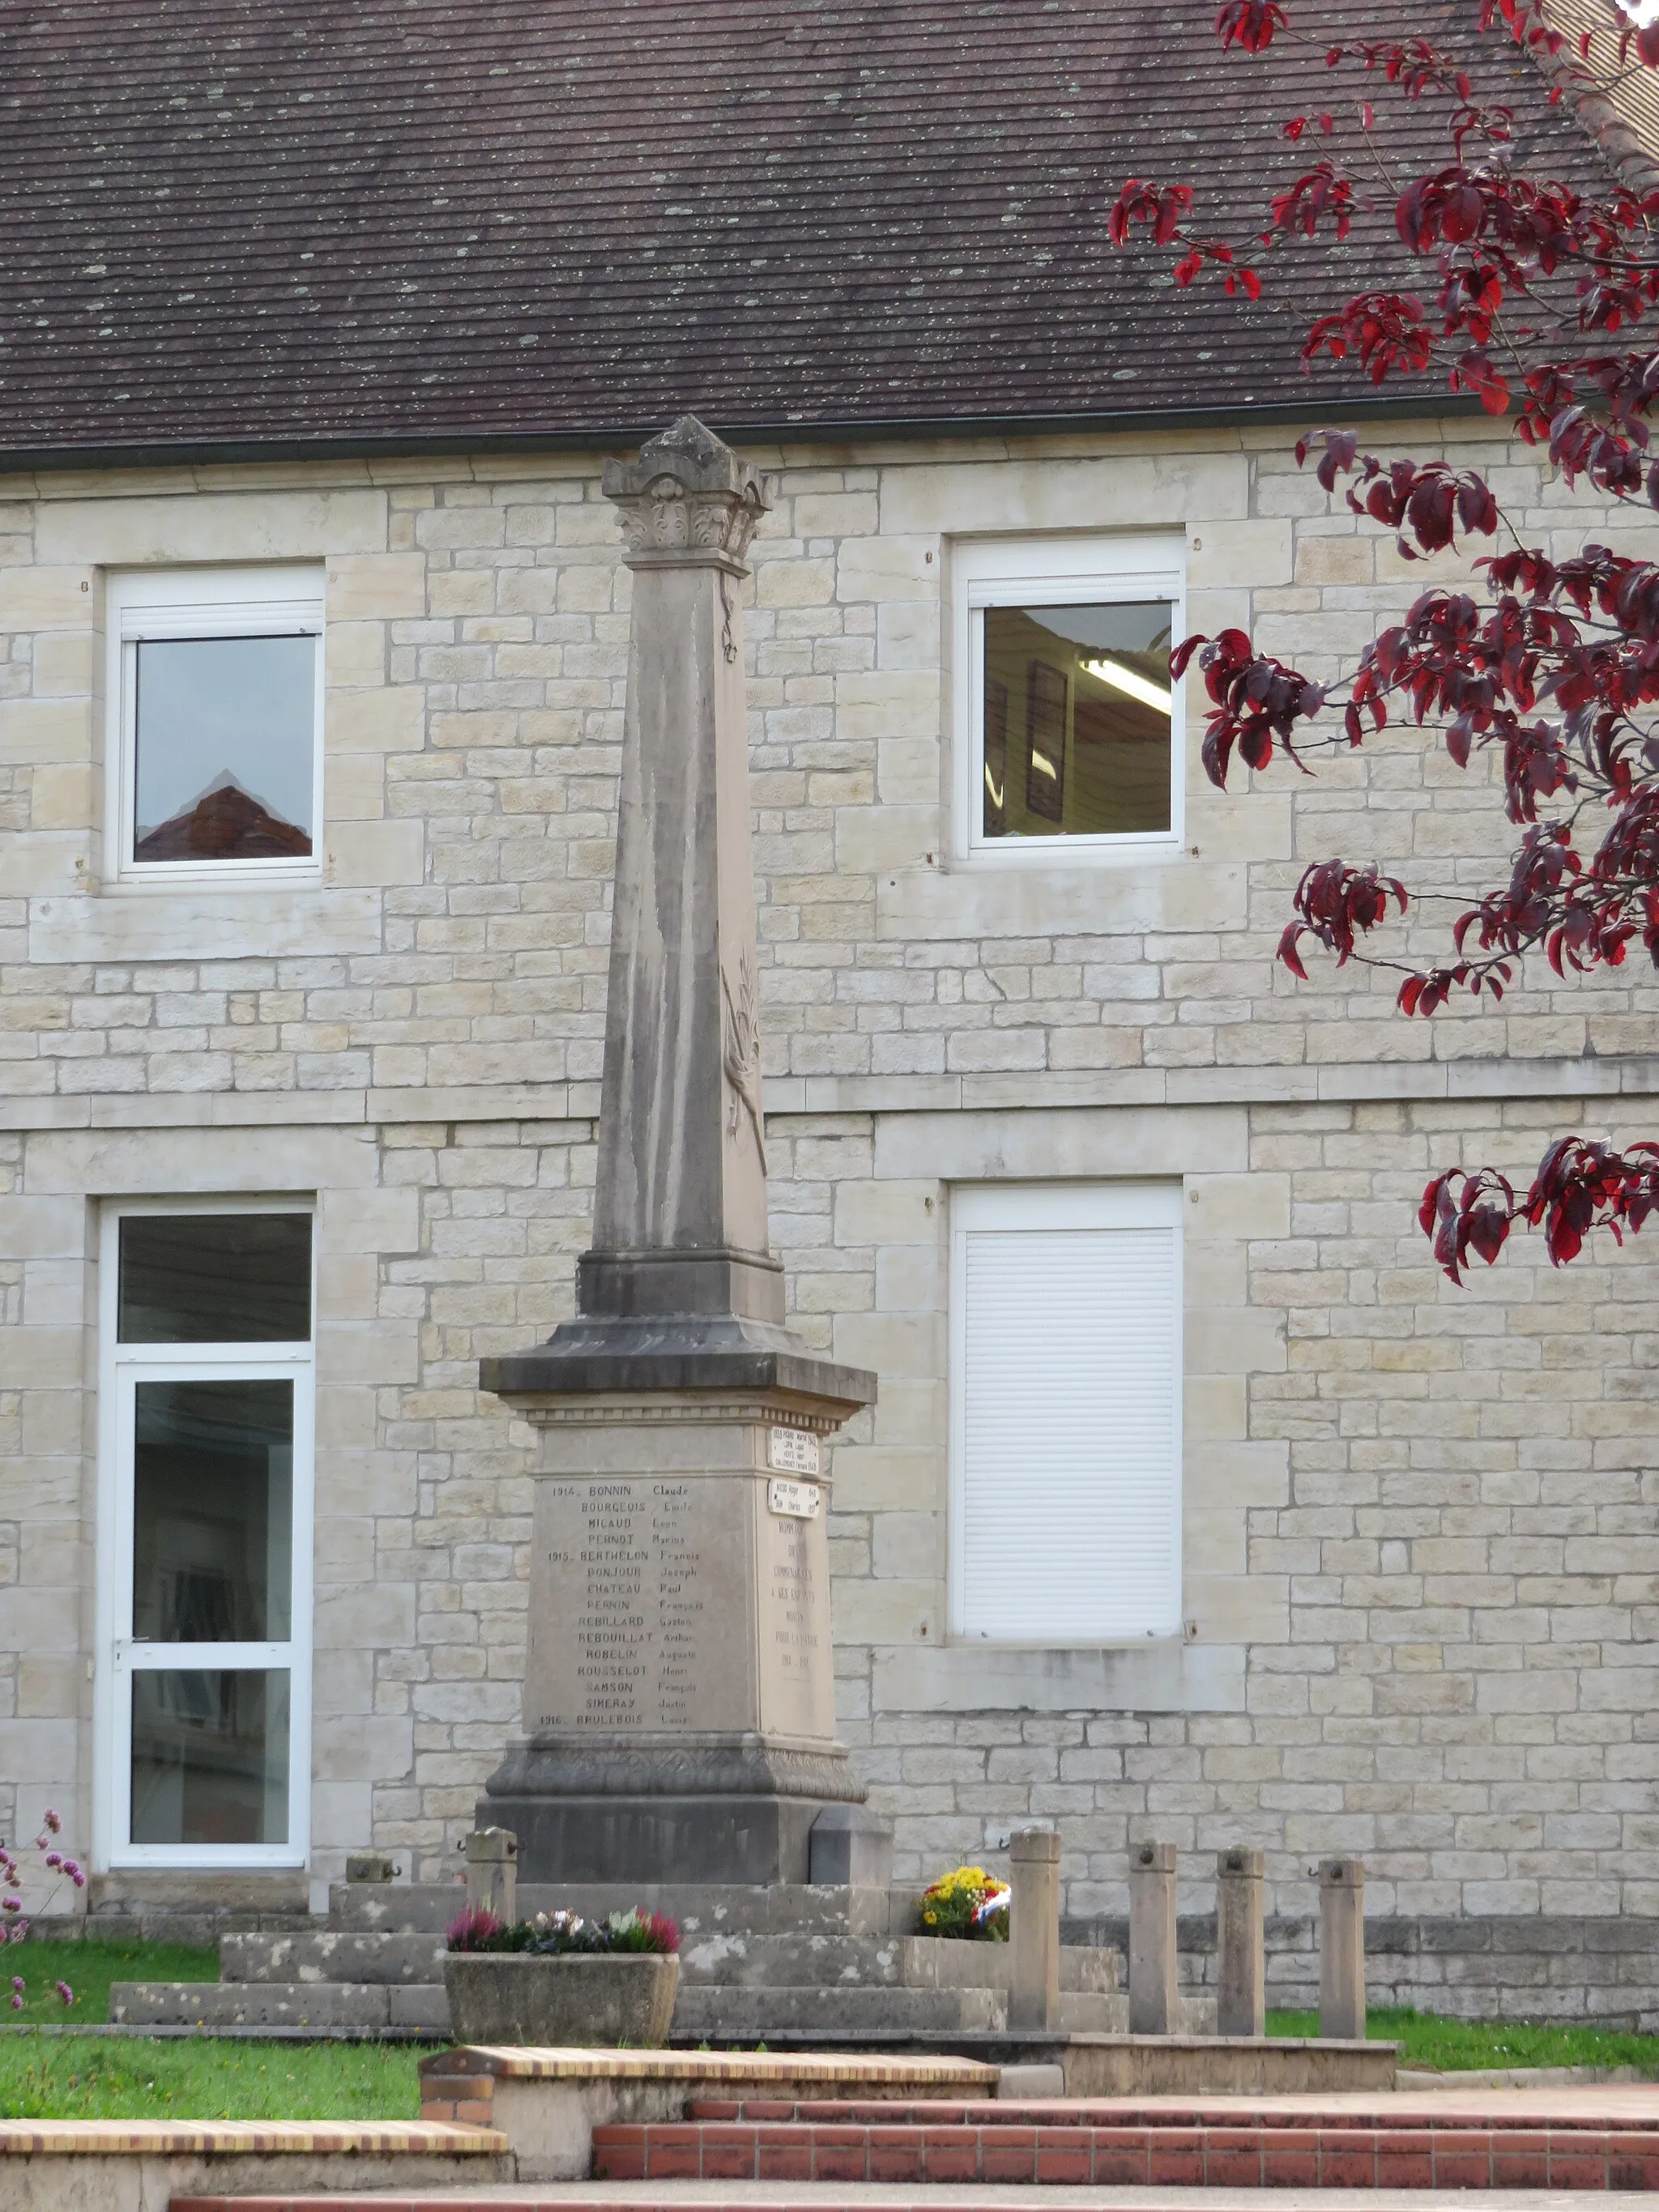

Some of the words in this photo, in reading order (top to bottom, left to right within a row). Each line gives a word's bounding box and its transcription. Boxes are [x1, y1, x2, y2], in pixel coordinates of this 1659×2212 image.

[589, 1486, 631, 1497] BONNIN
[653, 1485, 688, 1496] Claude
[582, 1502, 645, 1513] BOURGEOIS
[588, 1519, 631, 1529] MICAUD
[588, 1534, 634, 1545] PERNOT
[653, 1534, 685, 1545] Marius
[580, 1551, 649, 1562] BERTHELON
[659, 1551, 700, 1562] Francis
[587, 1567, 642, 1578] BONJOUR
[661, 1566, 697, 1579] Joseph
[587, 1584, 641, 1594] CHATEAU
[659, 1584, 681, 1594] Paul
[587, 1600, 629, 1610] PERNIN
[578, 1617, 644, 1626] REBILLARD
[659, 1617, 692, 1626] Gaston
[578, 1633, 653, 1643] REBOUILLAT
[664, 1633, 694, 1643] Arthur
[586, 1649, 637, 1660] ROBELIN
[578, 1666, 647, 1677] ROUSSELOT
[663, 1665, 688, 1676] Henri
[585, 1682, 633, 1693] SAMSON
[585, 1699, 635, 1709] SIMERAY
[658, 1699, 687, 1709] Justin
[577, 1715, 643, 1725] BRULEBOIS
